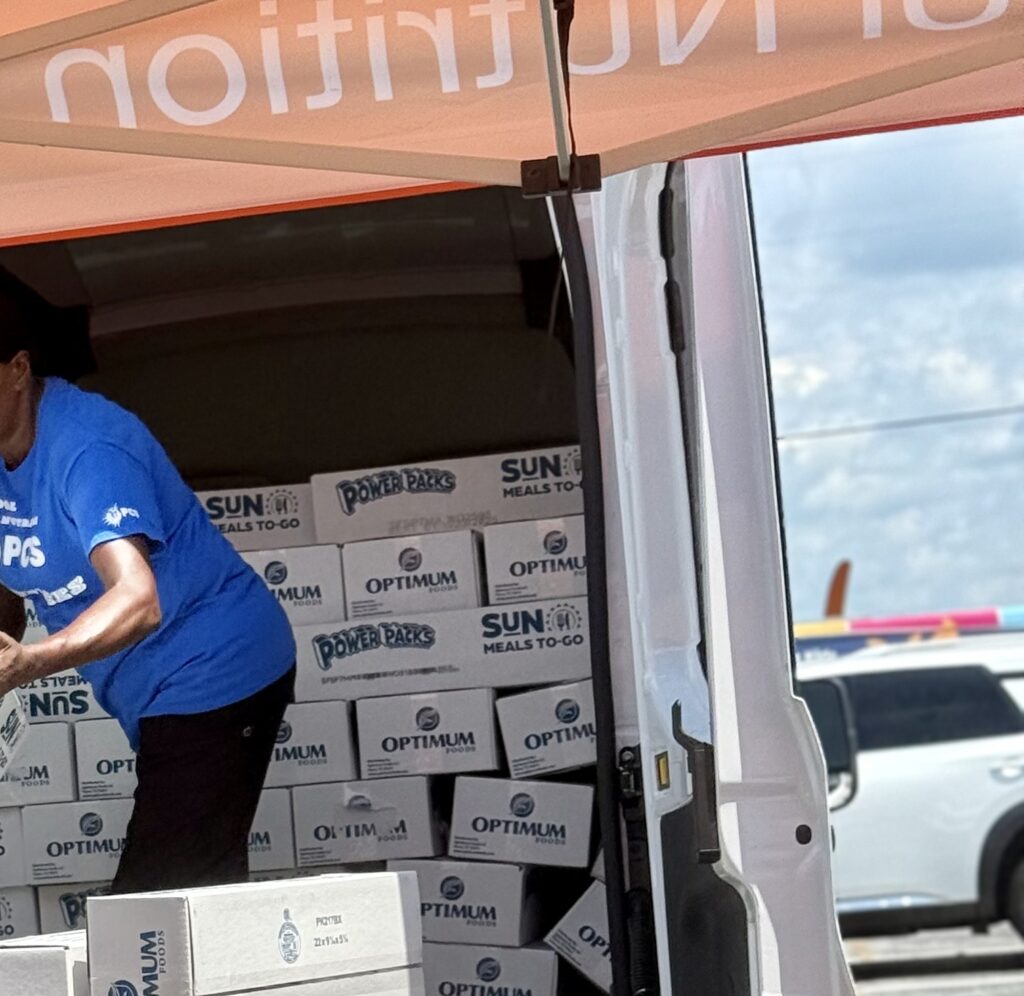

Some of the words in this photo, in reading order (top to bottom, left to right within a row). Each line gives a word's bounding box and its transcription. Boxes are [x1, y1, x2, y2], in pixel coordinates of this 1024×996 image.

[501, 454, 562, 483] SUN
[337, 470, 403, 515] POWER
[404, 468, 456, 494] PACKS
[503, 484, 551, 498] MEALS
[554, 481, 583, 493] TO-
[206, 494, 264, 519] SUN
[214, 520, 254, 533] EALS
[257, 518, 300, 531] TO-GO
[510, 556, 588, 577] OPTIMU
[366, 571, 457, 594] OPTIMUM
[481, 610, 544, 638] SUN
[312, 624, 377, 670] POWER
[377, 623, 435, 650] PACKS
[483, 639, 533, 655] MEALS
[538, 635, 584, 650] TO-GO
[29, 689, 89, 717] SUN
[381, 731, 475, 754] OPTIMUM
[524, 722, 597, 751] OPTIMU
[276, 744, 326, 761] IMUM
[471, 816, 566, 840] OPTIMUM
[421, 902, 497, 920] PTIMUM
[157, 930, 167, 974] FOODS
